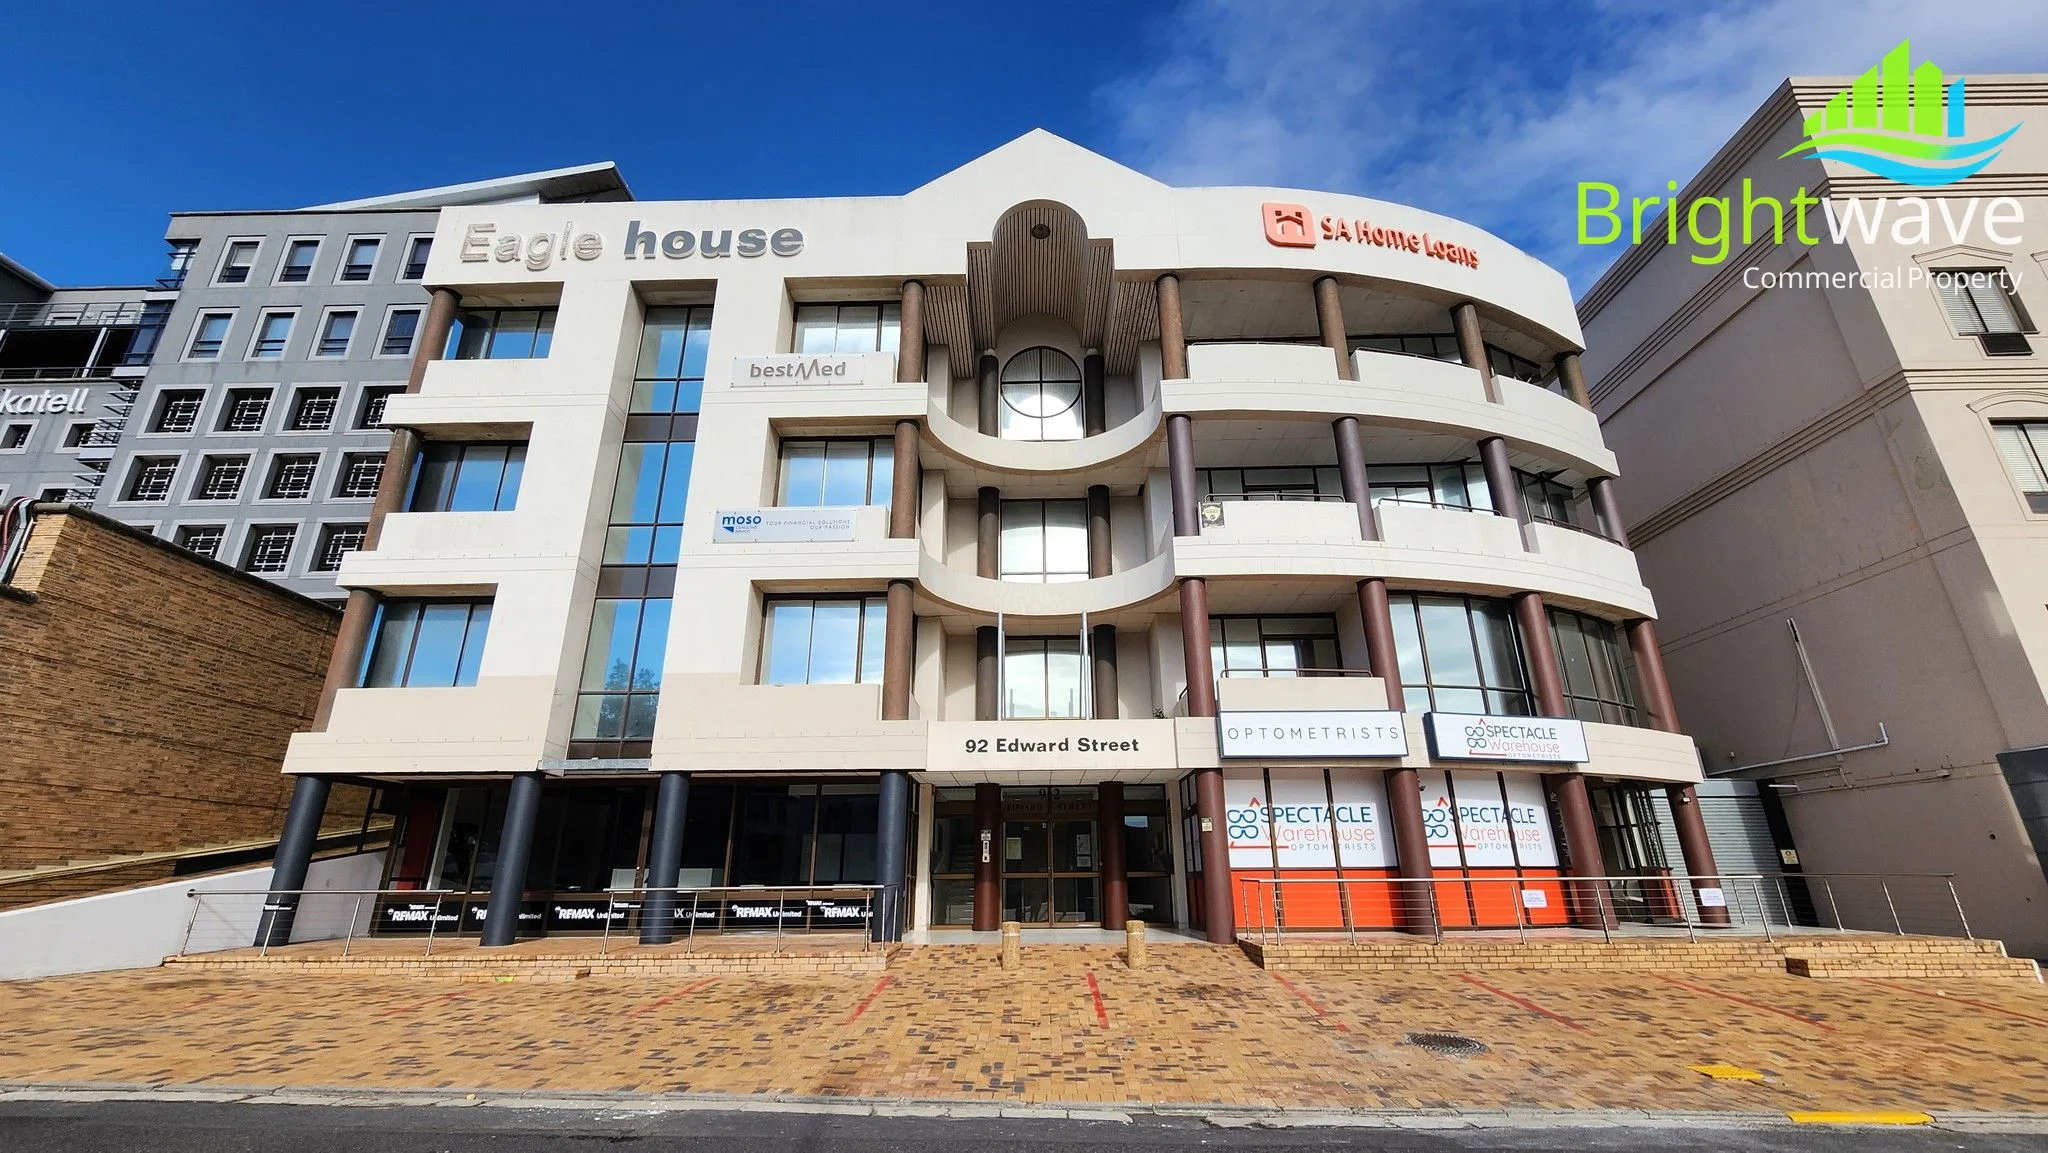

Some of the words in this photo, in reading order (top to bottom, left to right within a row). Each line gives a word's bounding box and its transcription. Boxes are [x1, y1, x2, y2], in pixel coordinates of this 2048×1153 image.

[460, 220, 603, 271] Eagle
[624, 220, 804, 260] house
[1321, 215, 1352, 242] SA
[1354, 218, 1420, 253] Home
[1422, 232, 1480, 270] Loans
[0, 387, 89, 413] katell
[722, 515, 761, 525] moso
[1227, 726, 1399, 740] OPTOMETRISTS
[1486, 725, 1558, 740] SPECTACLE
[965, 739, 989, 754] 92
[996, 737, 1069, 753] Edward
[1077, 737, 1139, 752] Street
[1488, 738, 1560, 753] Warehouse
[1260, 806, 1373, 823] SPECTACLE
[1450, 824, 1541, 842] Warehuse
[1290, 843, 1377, 851] OPTOMRISTS
[1478, 842, 1542, 851] OPTOMRISTS
